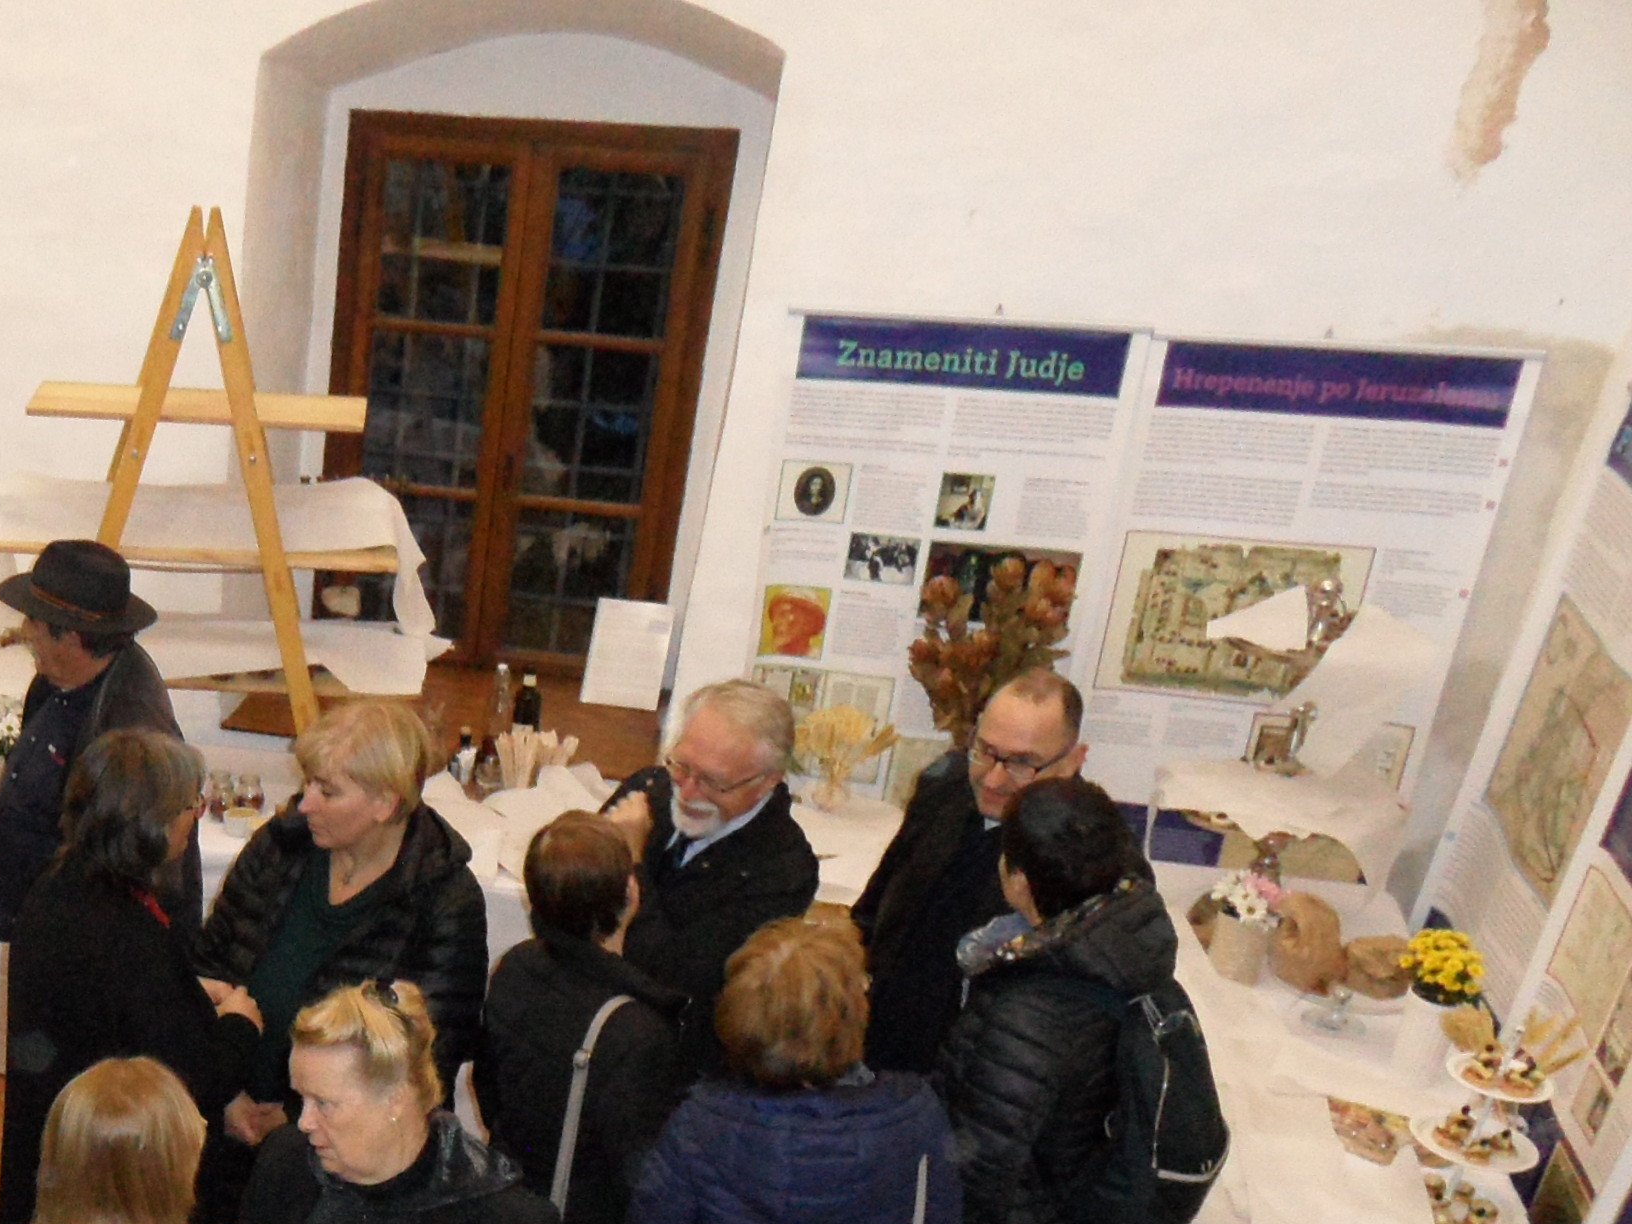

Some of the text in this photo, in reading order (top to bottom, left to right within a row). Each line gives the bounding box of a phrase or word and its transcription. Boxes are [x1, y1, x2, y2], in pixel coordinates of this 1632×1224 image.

[837, 339, 1085, 386] Znameniti Judje
[1319, 380, 1352, 405] po
